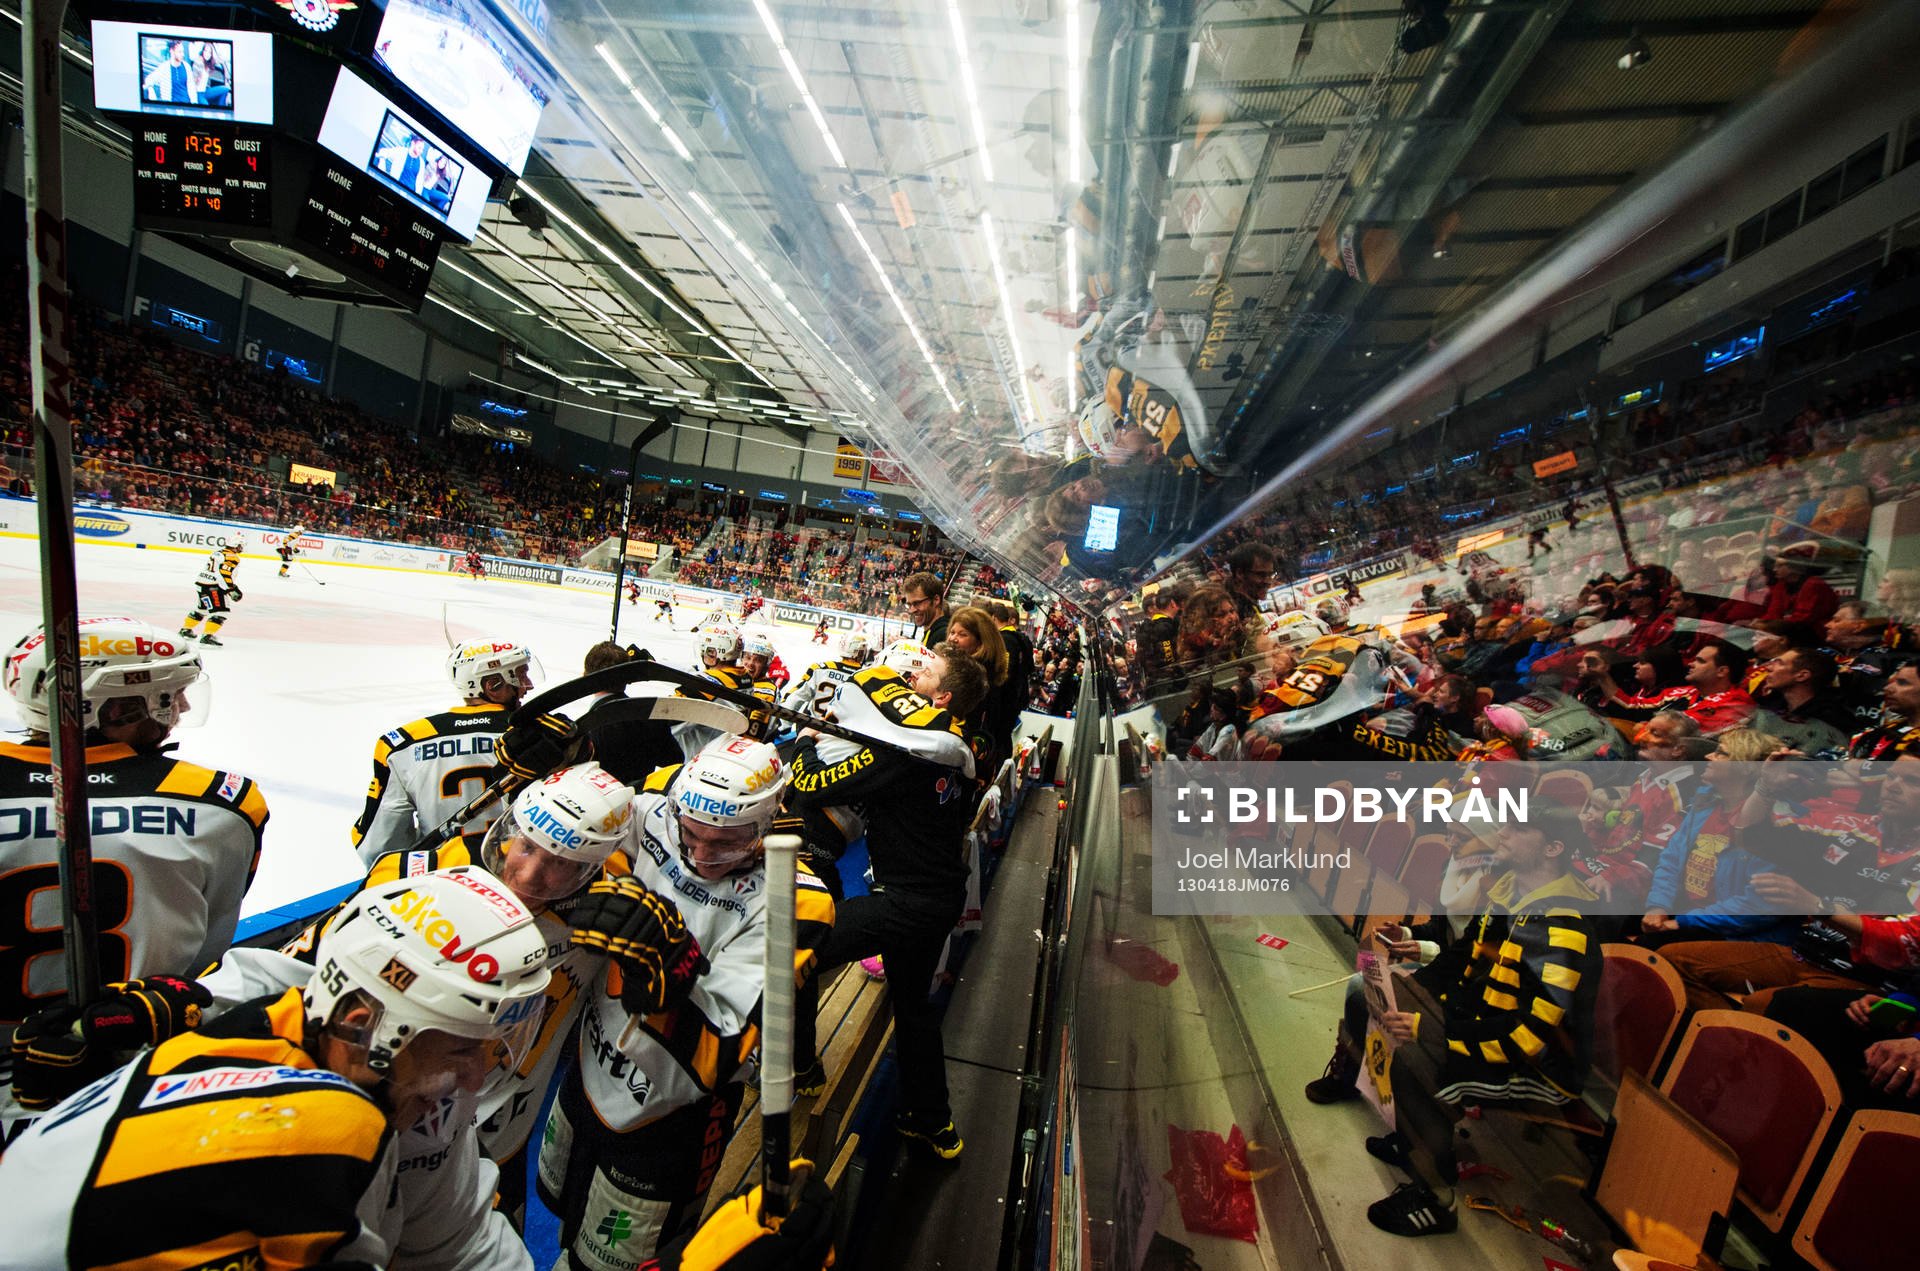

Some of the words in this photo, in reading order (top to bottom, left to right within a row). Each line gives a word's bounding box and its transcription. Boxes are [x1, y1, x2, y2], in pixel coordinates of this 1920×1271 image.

[144, 131, 167, 143] HOME
[185, 135, 222, 156] 19:25
[234, 139, 261, 152] GUEST
[155, 146, 165, 164] 0
[247, 156, 257, 172] 4
[138, 170, 152, 178] PLYR
[155, 171, 177, 181] PENALTY
[184, 161, 204, 171] PERIOD
[206, 161, 213, 174] 3
[225, 178, 240, 187] PLYR
[243, 180, 267, 190] PENALTY
[327, 168, 353, 191] HOME
[181, 184, 199, 194] SHOTS
[208, 187, 222, 196] GOAL
[207, 197, 221, 210] 40
[308, 198, 324, 212] PLYR
[326, 209, 352, 227] PENALTY
[360, 215, 380, 231] PERIOD
[411, 222, 435, 241] GUEST
[350, 233, 369, 247] SHOTS
[376, 247, 390, 259] GOAL
[409, 256, 430, 271] PENALTY
[134, 296, 150, 316] F
[245, 342, 259, 362] G
[838, 458, 862, 471] 1996
[168, 532, 227, 547] SWECO
[775, 607, 820, 625] VOLVIA
[79, 635, 175, 656] skebo
[463, 642, 513, 658] skebo
[468, 681, 476, 689] 2
[81, 700, 92, 714] 8
[893, 693, 929, 716] 21
[454, 716, 492, 728] Reebok
[680, 790, 738, 817] AllTele
[523, 804, 583, 850] AllTele
[1656, 823, 1677, 841] 2
[366, 904, 406, 940] CCM
[389, 890, 500, 983] skebo
[319, 957, 349, 997] 55
